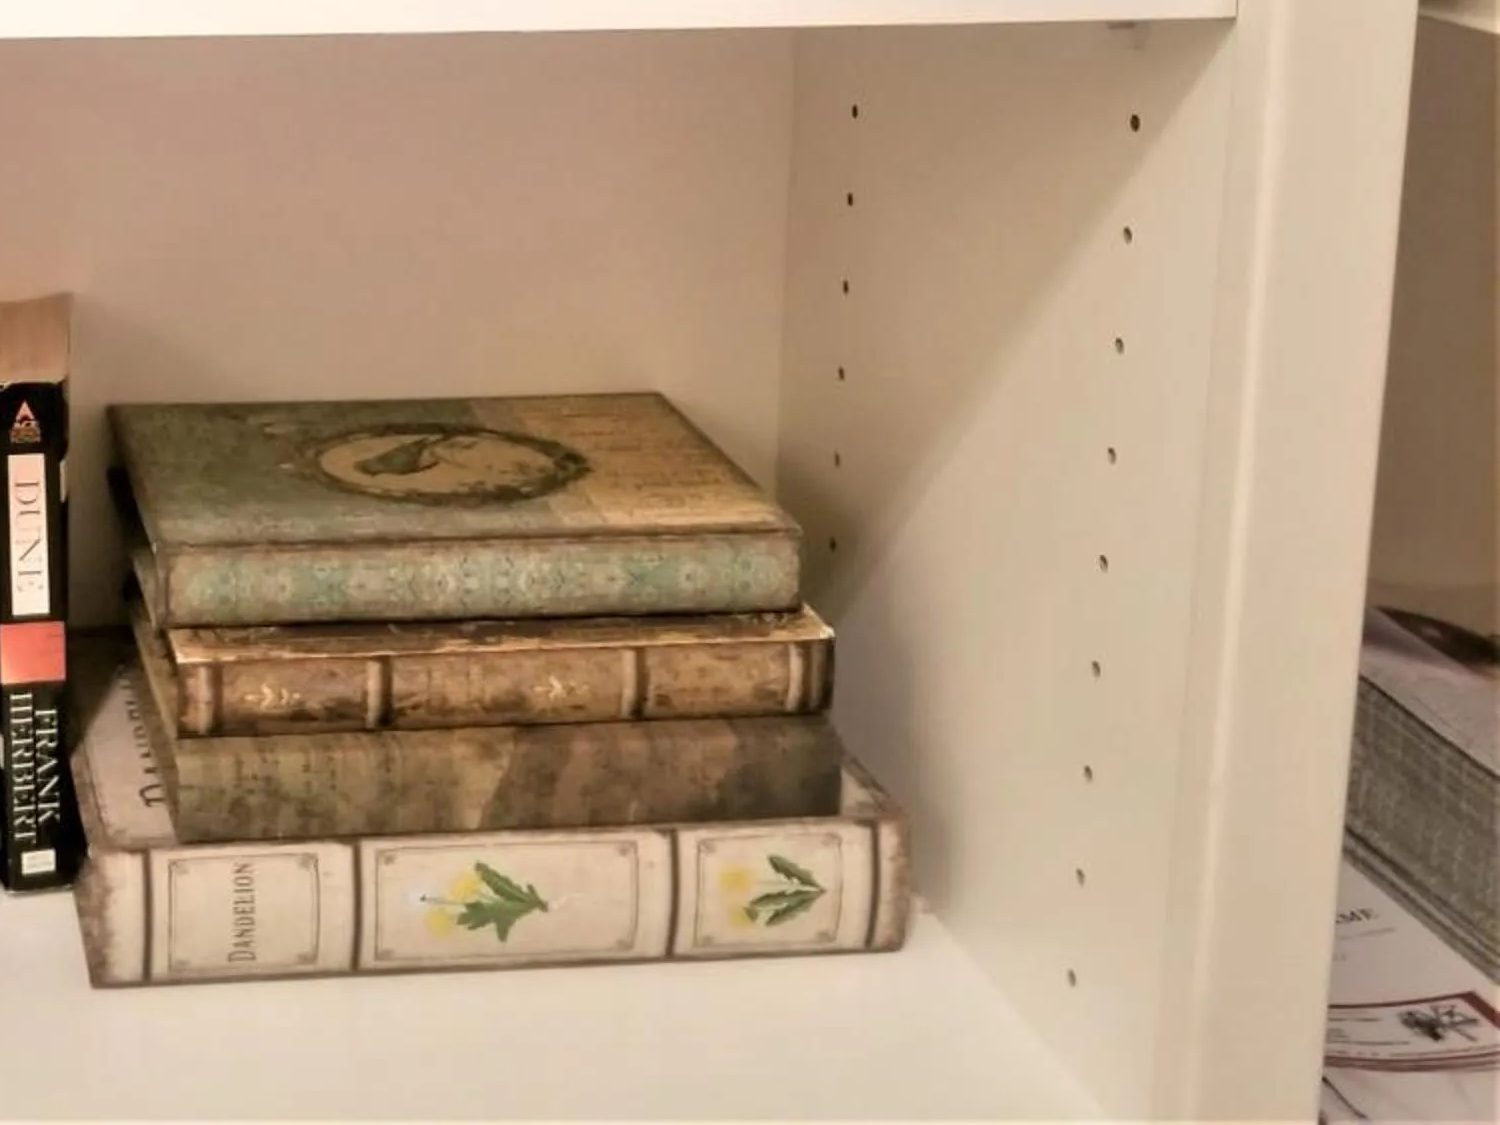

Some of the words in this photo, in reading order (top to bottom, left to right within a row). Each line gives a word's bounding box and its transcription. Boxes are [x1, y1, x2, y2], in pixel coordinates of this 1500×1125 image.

[10, 693, 37, 844] HERBERT
[34, 709, 60, 823] FRANK
[228, 861, 257, 963] DANDELION
